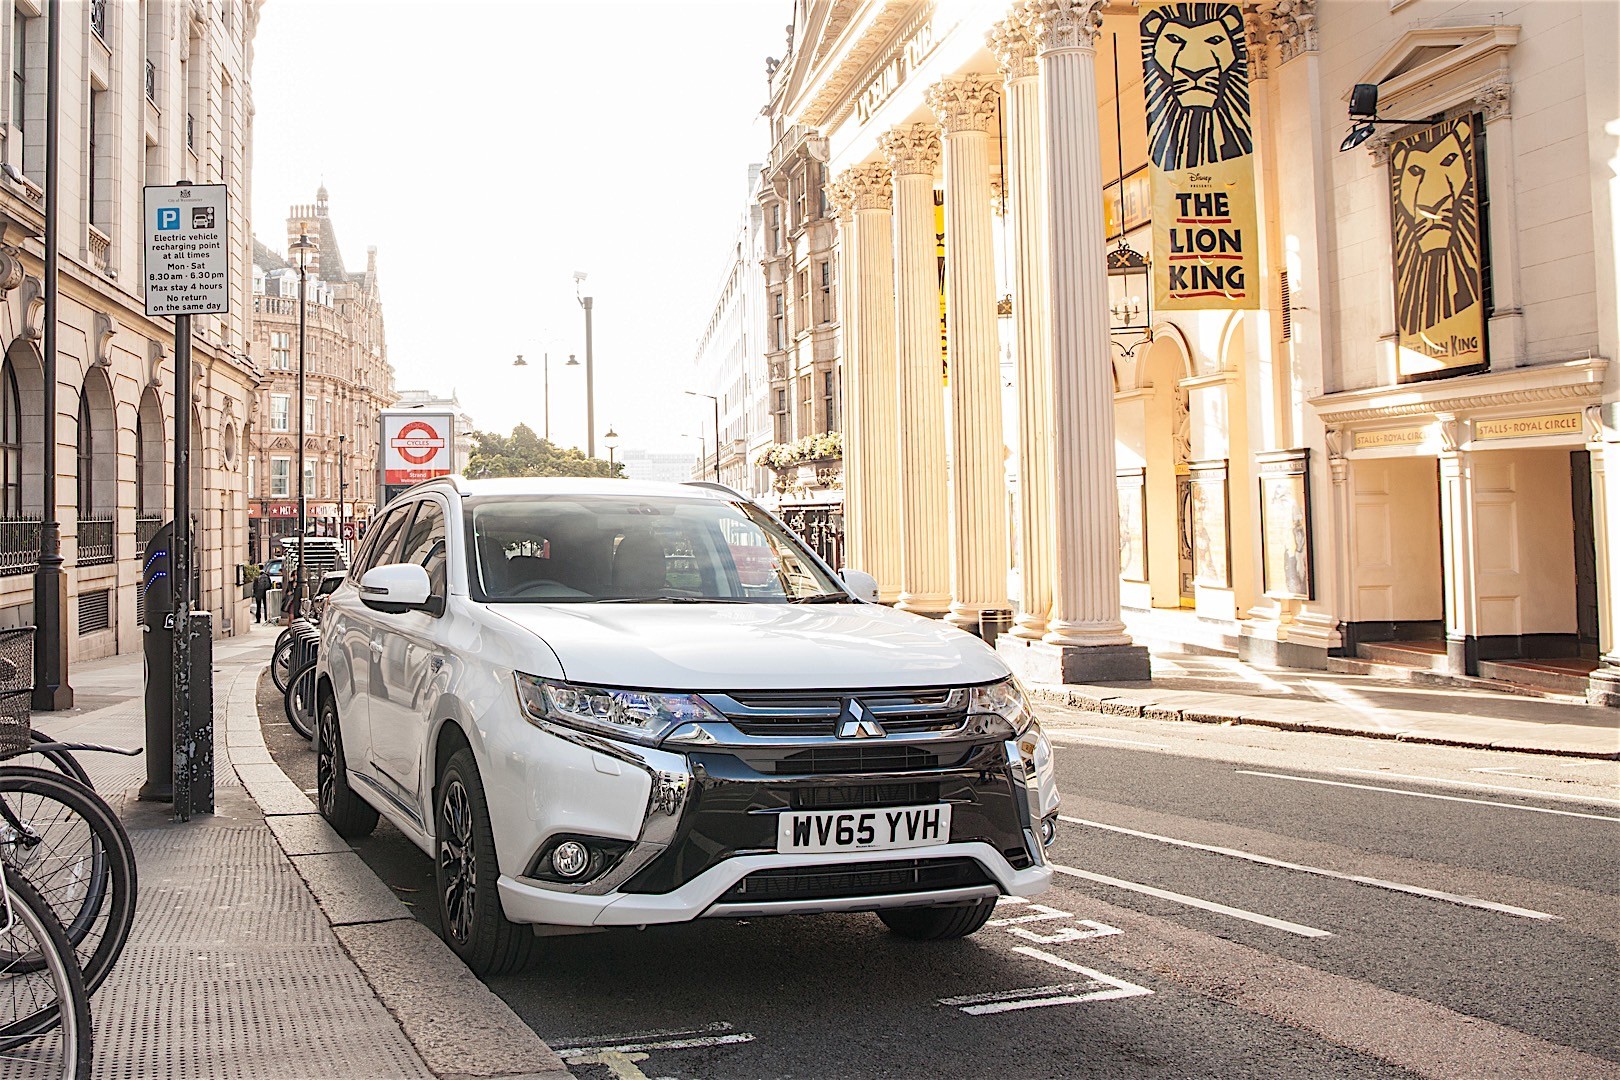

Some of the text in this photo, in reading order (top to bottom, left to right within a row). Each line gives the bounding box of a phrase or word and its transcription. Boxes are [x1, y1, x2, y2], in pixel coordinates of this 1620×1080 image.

[1187, 172, 1212, 183] Disney
[1176, 192, 1230, 217] THE
[162, 210, 177, 228] P
[154, 233, 218, 242] Electric vehicle
[1169, 228, 1242, 253] LION
[152, 242, 220, 251] recharging point
[187, 251, 210, 259] times
[191, 262, 205, 270] Sat
[1168, 265, 1245, 291] KING
[151, 284, 168, 292] Max
[170, 284, 188, 292] stay
[199, 282, 223, 290] hours
[166, 303, 180, 311] the
[206, 302, 221, 310] day
[1544, 418, 1577, 429] CIRCLE
[792, 808, 940, 847] WV65 YVH
